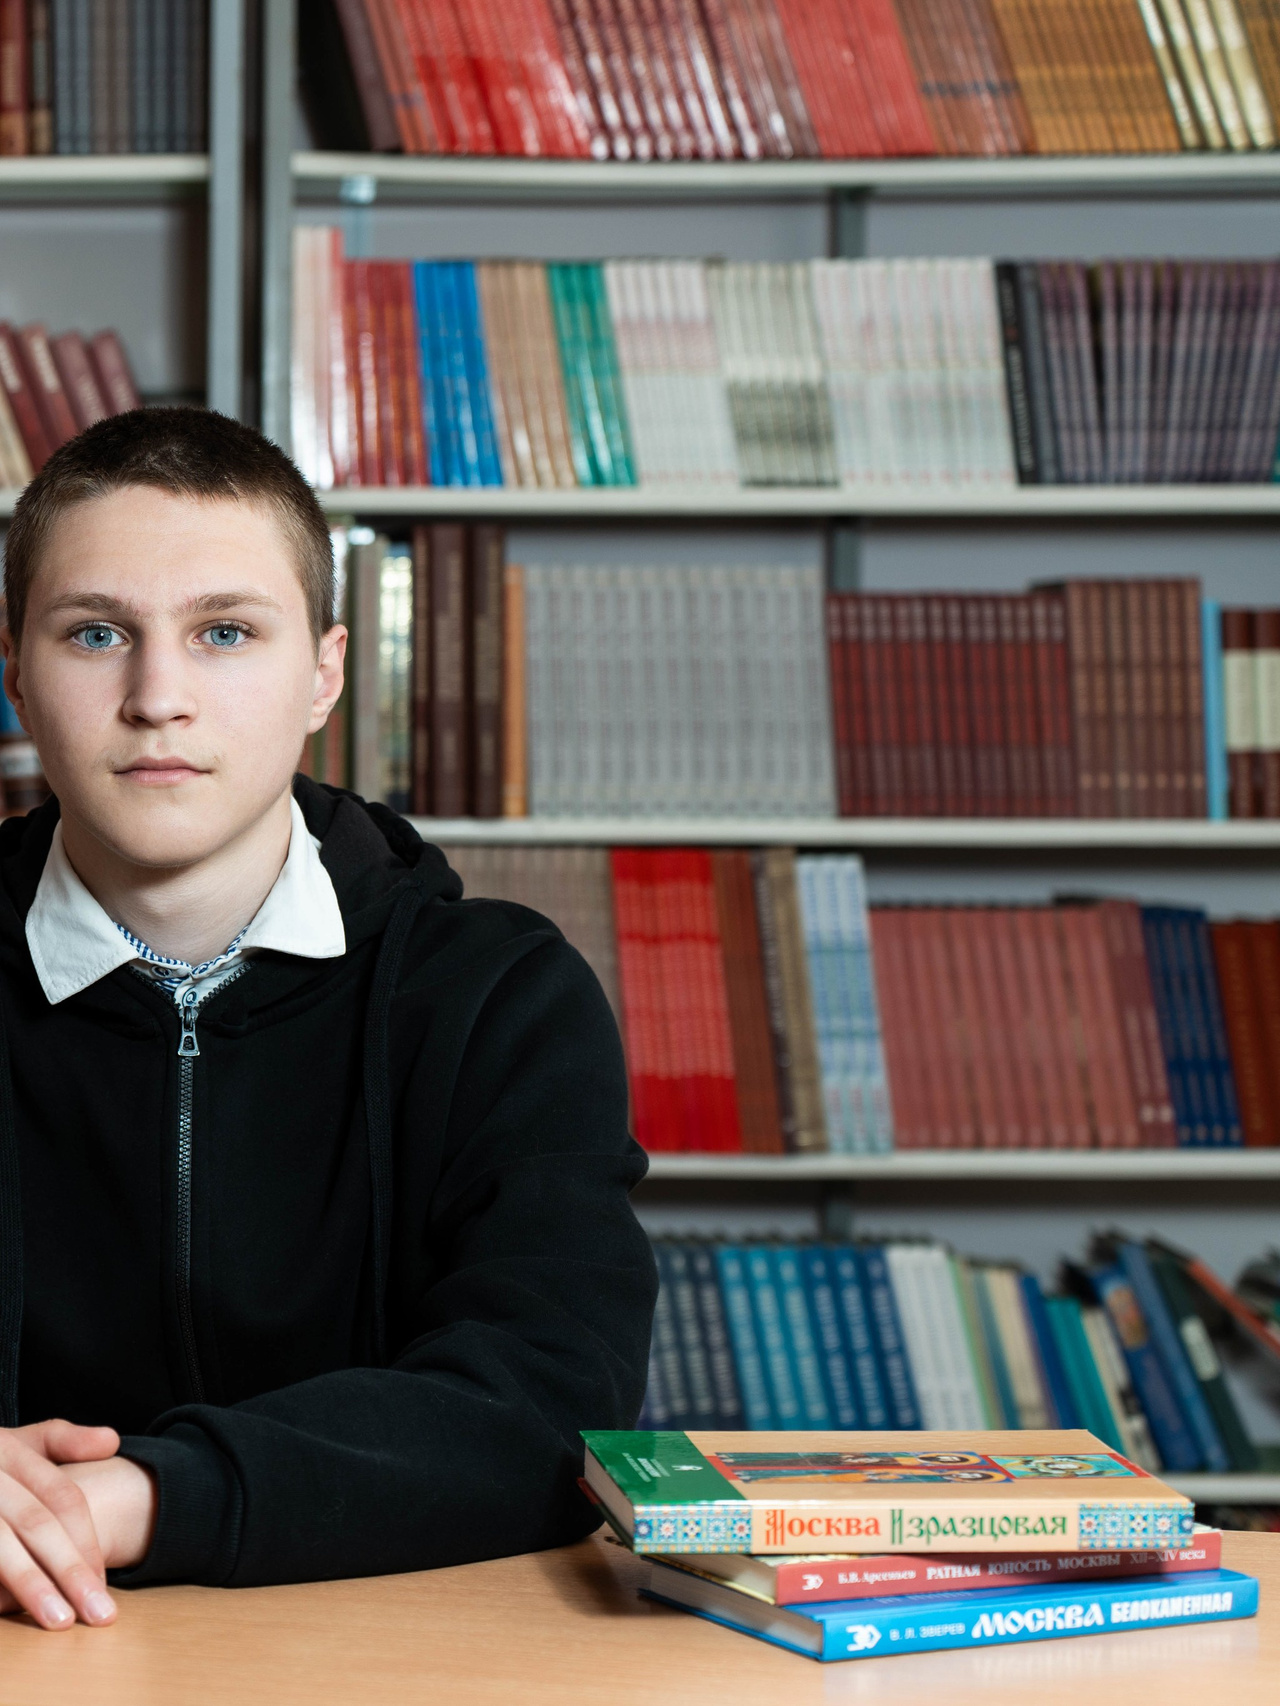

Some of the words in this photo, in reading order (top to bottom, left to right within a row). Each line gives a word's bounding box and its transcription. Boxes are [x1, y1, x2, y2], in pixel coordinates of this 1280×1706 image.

[765, 1508, 881, 1546] Москва
[890, 1508, 1067, 1545] Изразцовая
[862, 1569, 917, 1584] Арсеньев
[926, 1563, 982, 1581] РАТНАЯ
[987, 1558, 1052, 1576] ЮНОСТЬ
[1057, 1553, 1121, 1571] МОСКВЫ
[1179, 1549, 1207, 1561] века
[919, 1622, 966, 1639] ЗВЕРЕВ
[971, 1602, 1105, 1640] МОСКВА
[1111, 1591, 1233, 1624] БЕЛОКАМЕННАЯ
